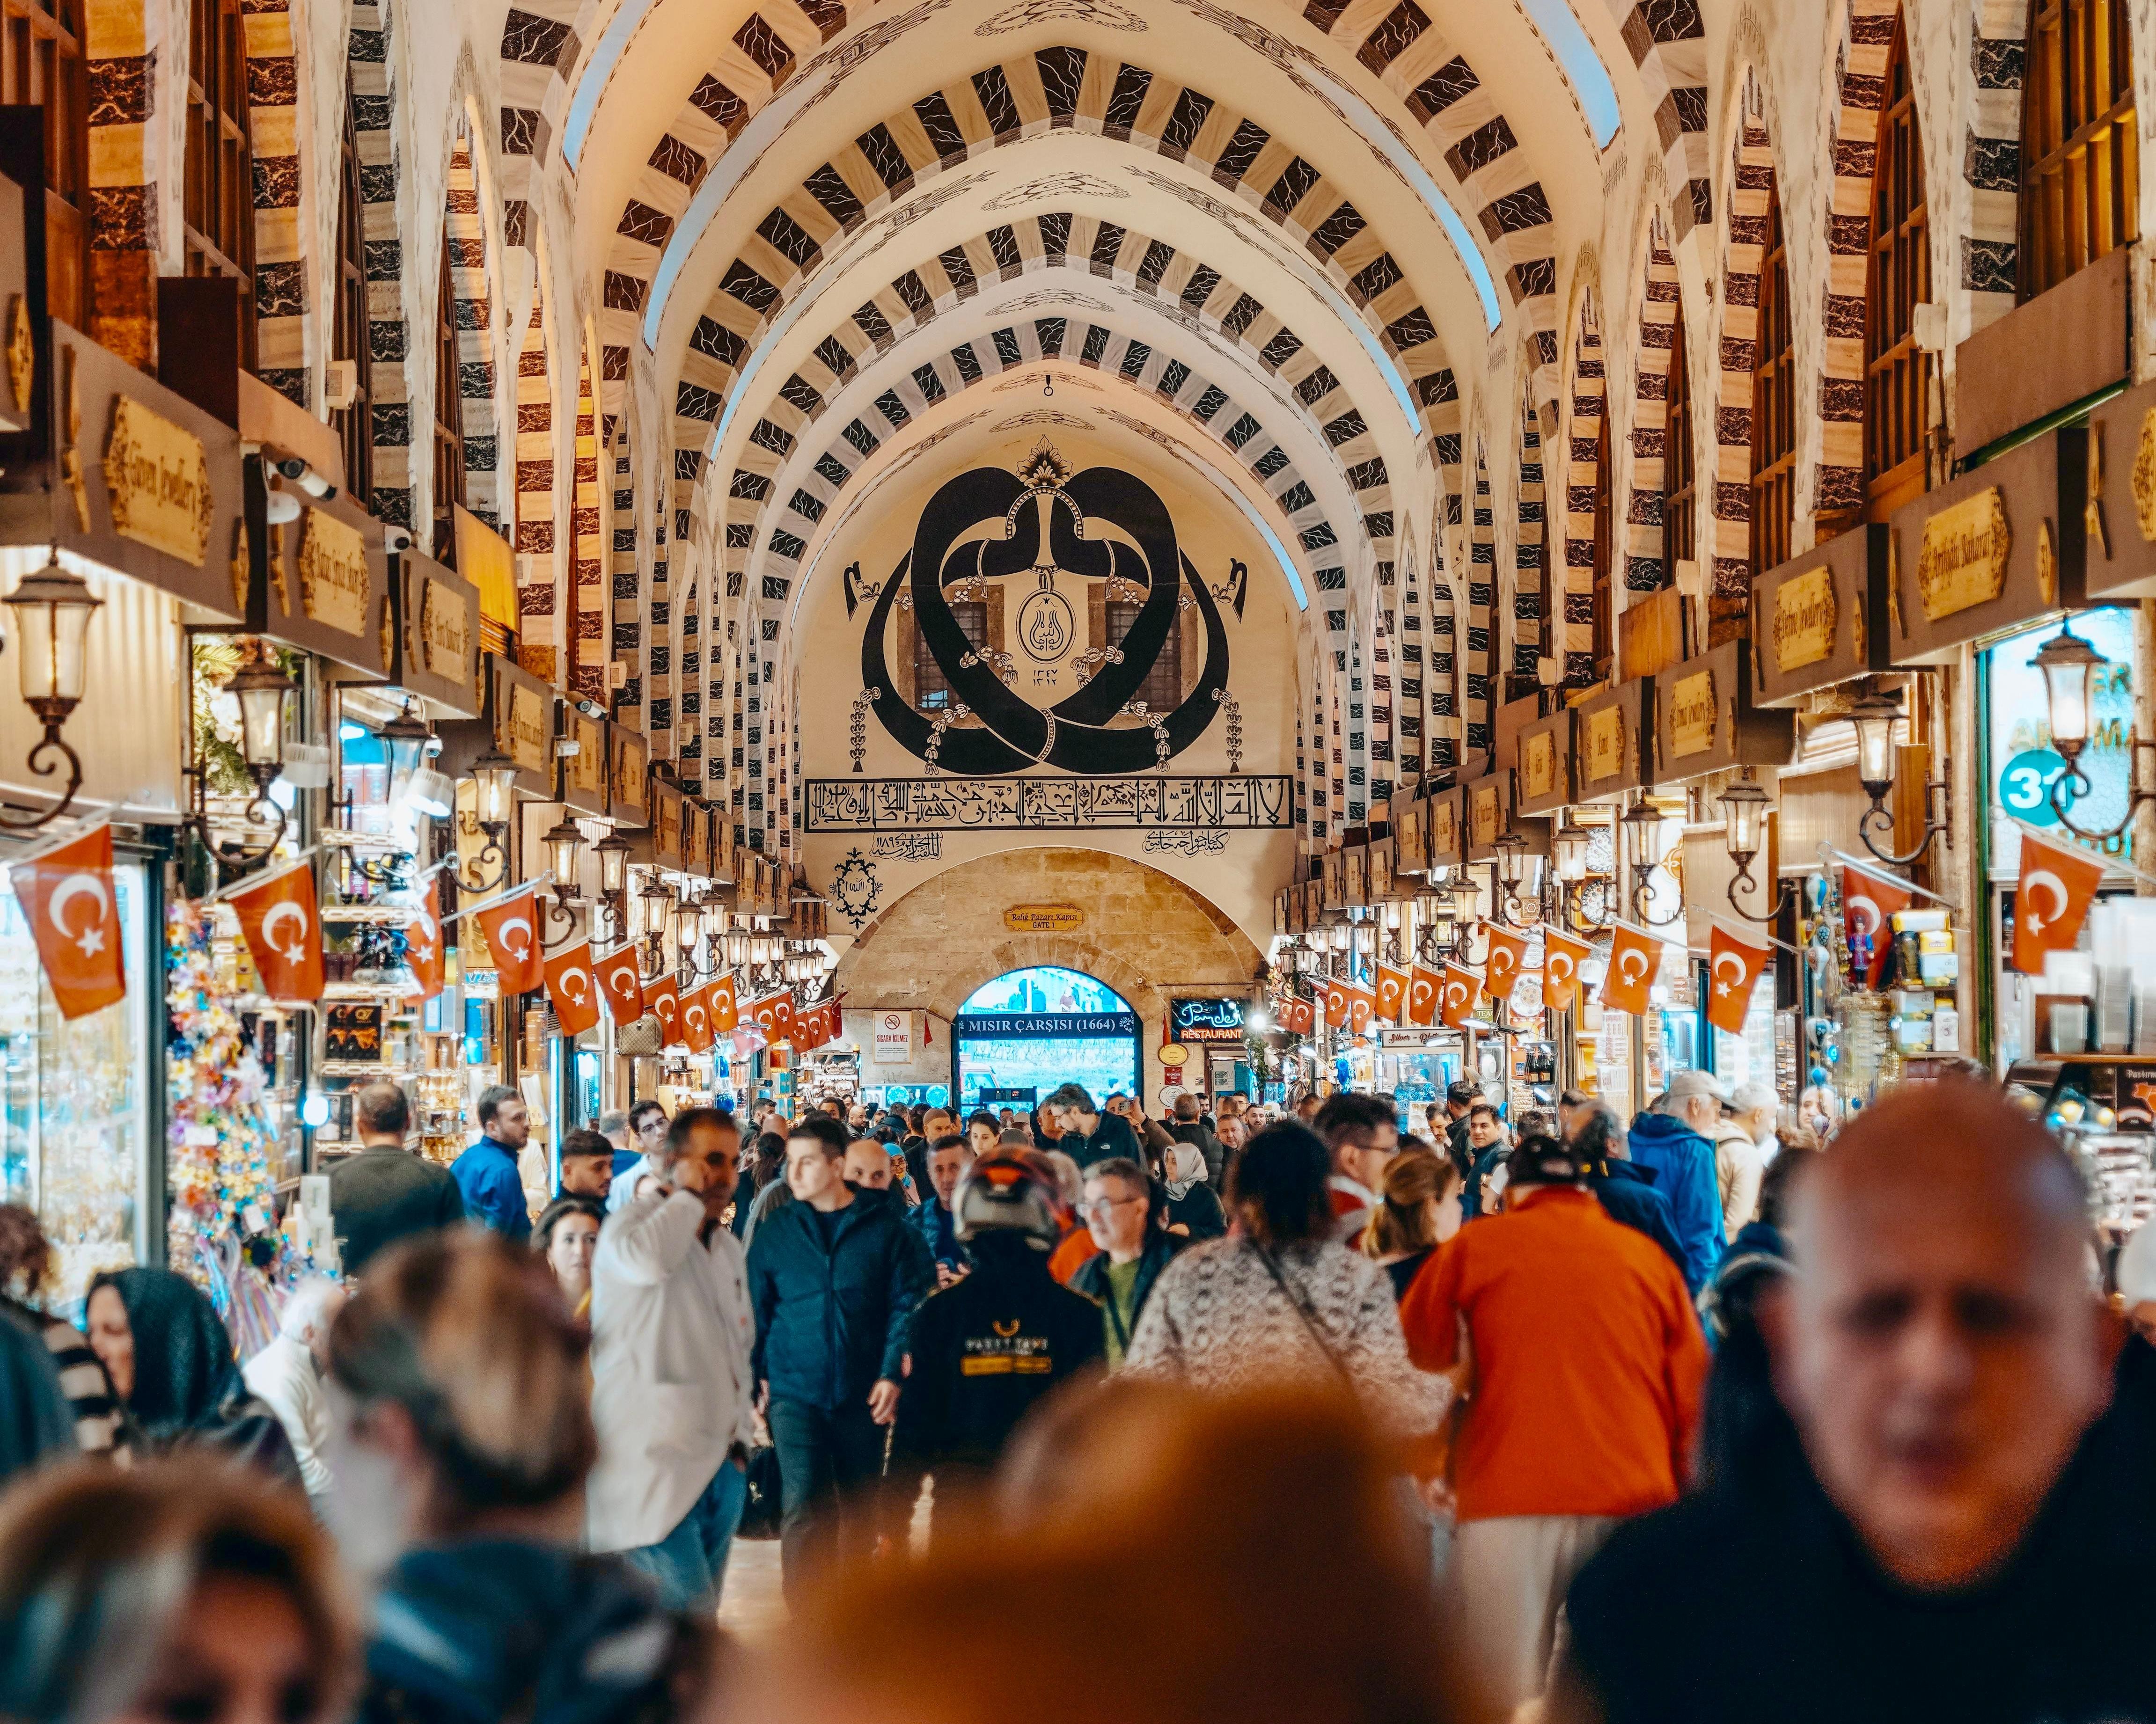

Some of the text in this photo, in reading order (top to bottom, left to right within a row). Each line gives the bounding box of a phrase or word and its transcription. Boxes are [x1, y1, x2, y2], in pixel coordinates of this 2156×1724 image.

[969, 1021, 1011, 1031] MISIR
[1077, 1019, 1115, 1032] (1664)
[1182, 1030, 1243, 1039] RESTAURANT
[1388, 1033, 1411, 1044] Silver
